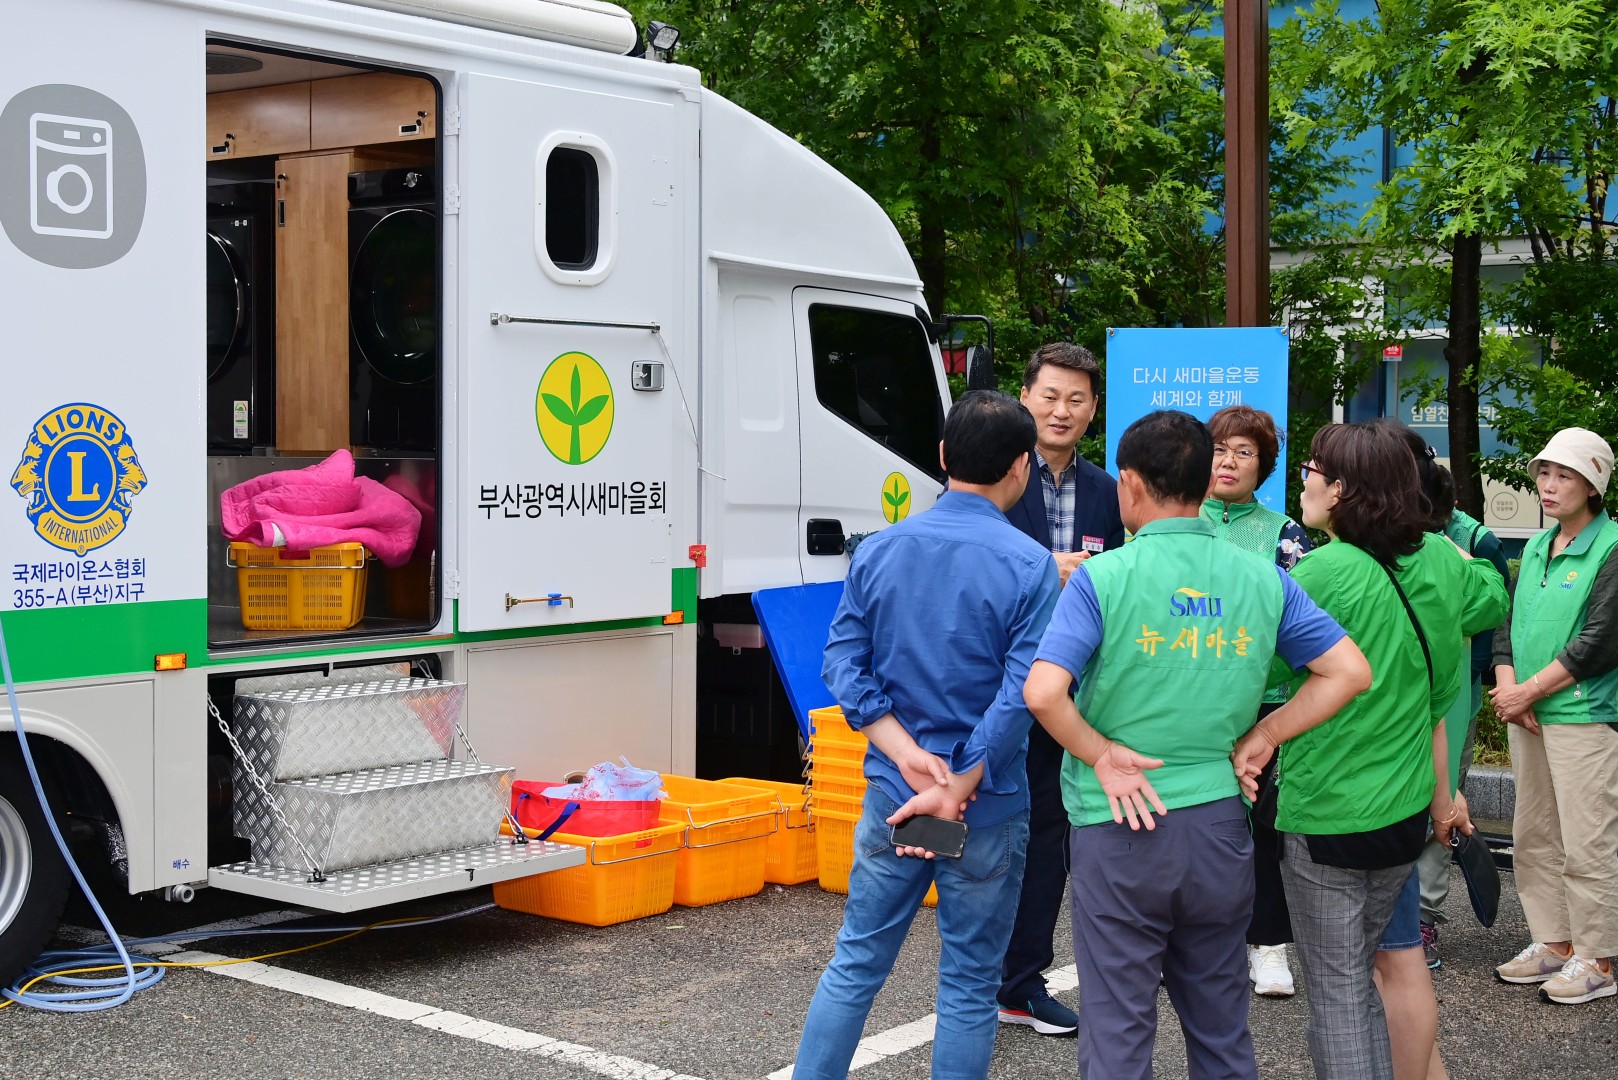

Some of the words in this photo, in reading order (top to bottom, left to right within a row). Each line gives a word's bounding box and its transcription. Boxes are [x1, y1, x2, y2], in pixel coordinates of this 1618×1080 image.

[1133, 367, 1167, 384] 다시
[1173, 366, 1260, 384] 새마을운동
[1150, 390, 1203, 407] 세계와
[1207, 390, 1243, 407] 함께
[42, 409, 119, 441] LIONS
[66, 451, 101, 502] L
[478, 481, 666, 519] 부산광역시새마을회
[43, 516, 119, 544] INTERNATIONAL
[12, 557, 146, 585] 국제라이온스협회
[1169, 593, 1222, 618] SMU
[172, 858, 191, 870] 배수
